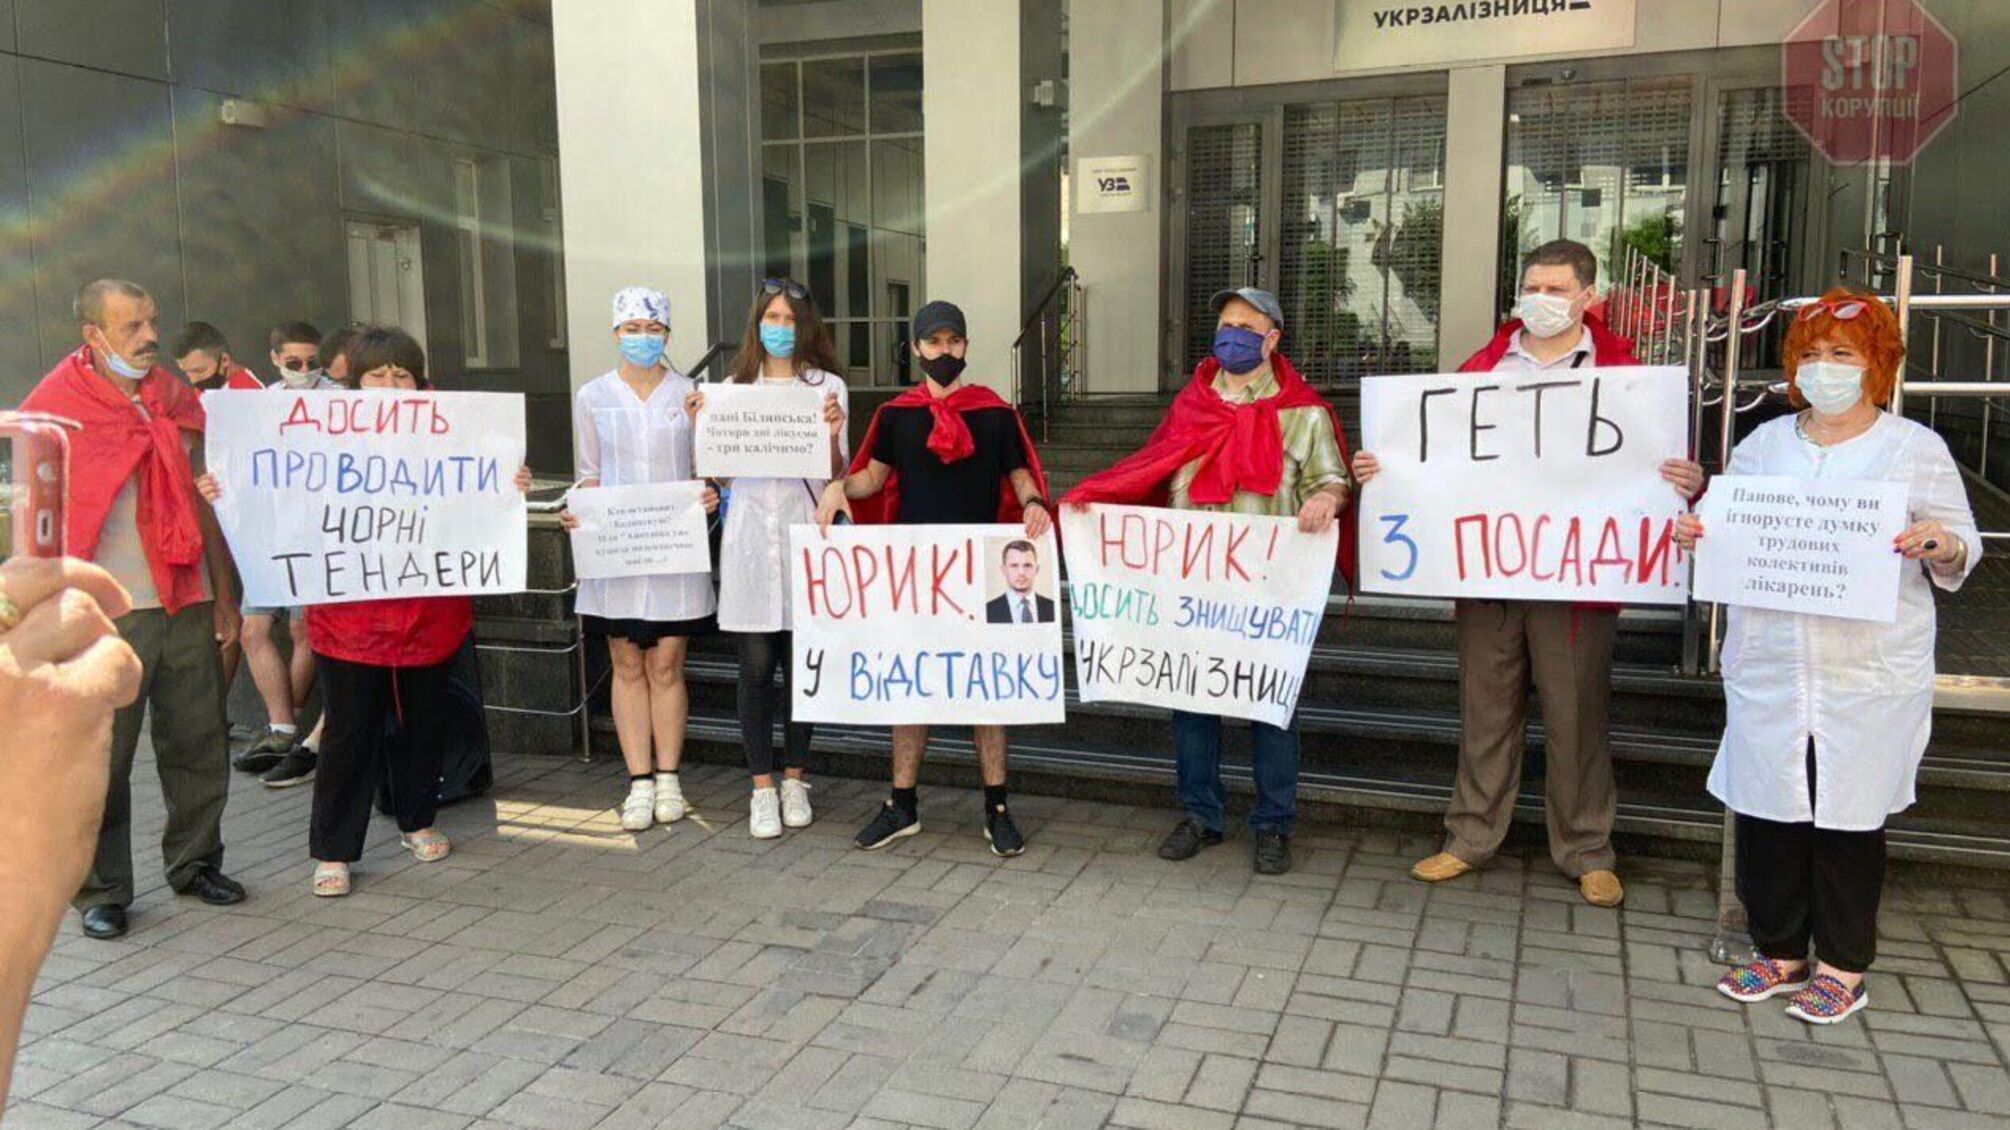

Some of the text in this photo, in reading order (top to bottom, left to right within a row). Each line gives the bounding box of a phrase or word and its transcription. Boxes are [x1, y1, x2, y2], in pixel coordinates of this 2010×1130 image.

[1374, 0, 1566, 29] УКРЗАЛІЗНИЦЯ
[280, 397, 450, 435] ДОСИТЬ
[1420, 378, 1624, 463] ГЕТЬ
[717, 444, 740, 455] три
[744, 443, 815, 455] калічимо?
[253, 449, 500, 497] ПРОВОДИТИ
[1733, 487, 1880, 512] Панове, чому ви
[1817, 517, 1880, 536] думку
[1757, 535, 1841, 553] трудових
[271, 551, 502, 597] ТЕНДЕРИ
[803, 538, 975, 620] ЮРИК!
[1747, 556, 1849, 576] колективів
[1744, 576, 1847, 599] лікарень?
[803, 648, 825, 698] У
